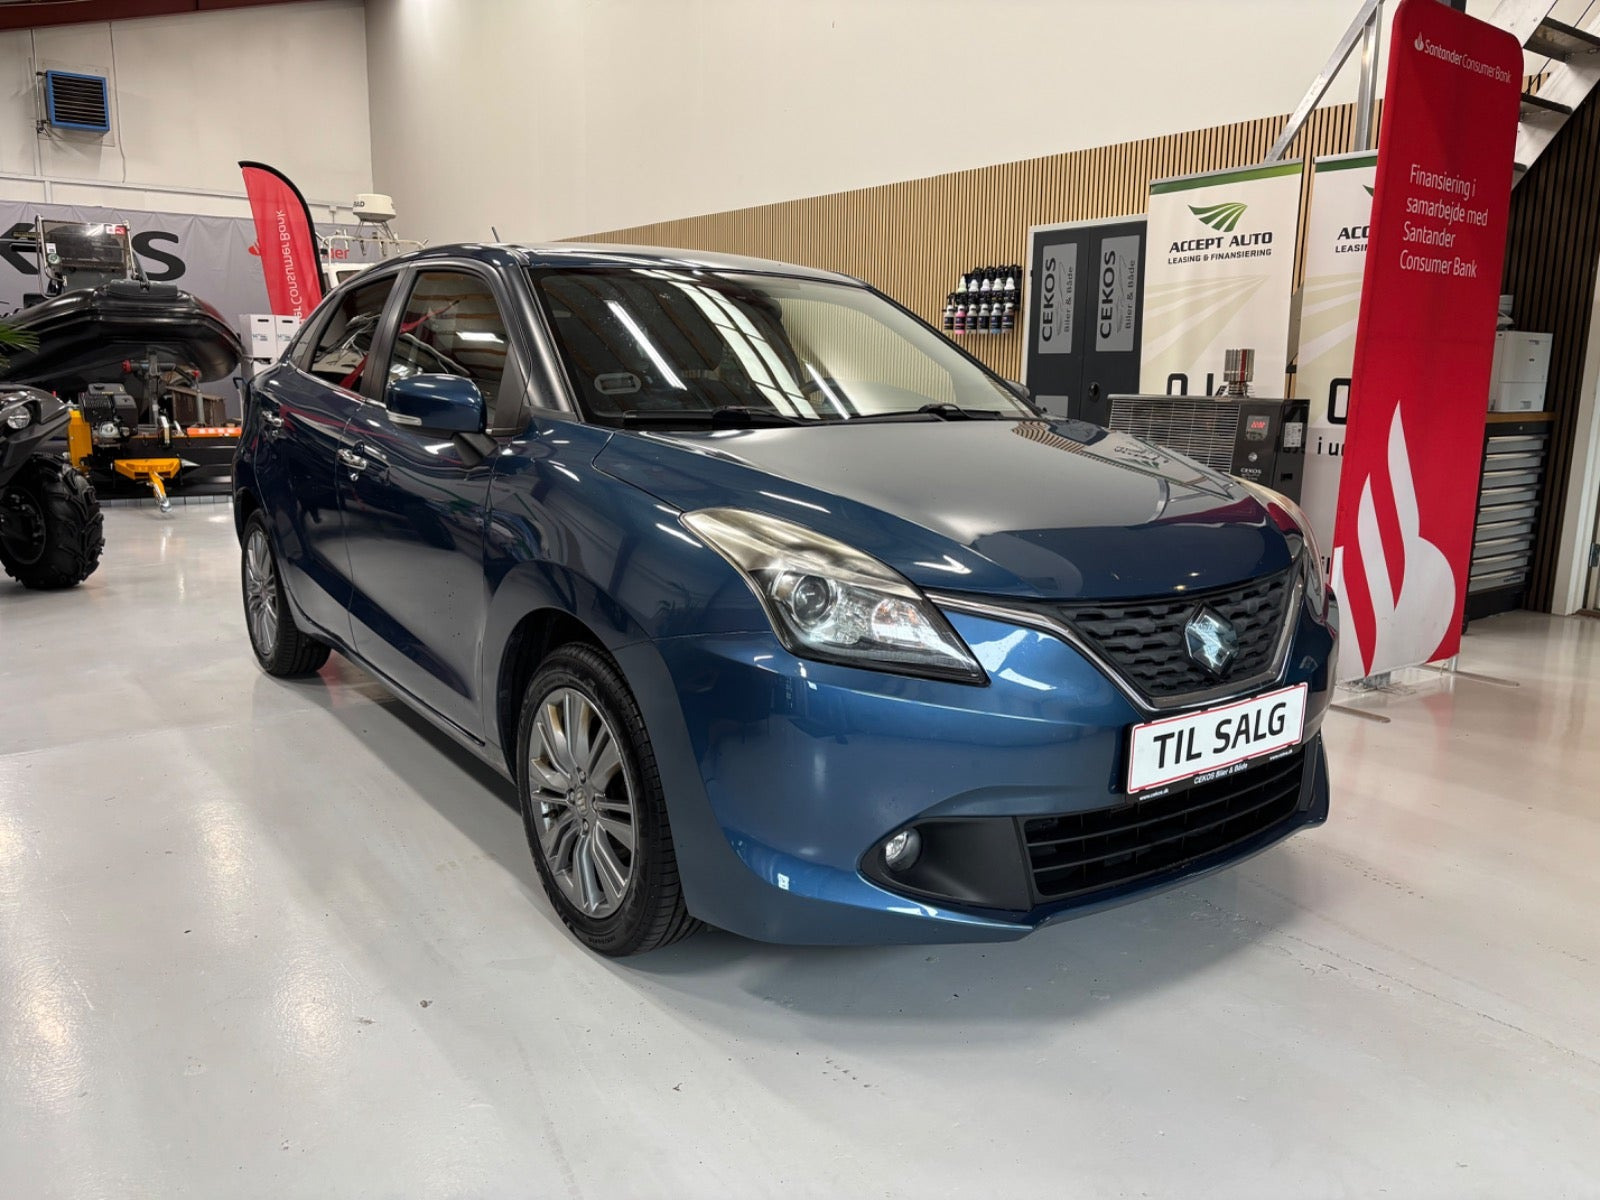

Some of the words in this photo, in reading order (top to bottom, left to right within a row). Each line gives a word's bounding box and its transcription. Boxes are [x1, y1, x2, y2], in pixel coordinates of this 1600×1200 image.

[1424, 39, 1463, 63] Santander
[1462, 53, 1496, 78] Consumer
[1495, 66, 1512, 84] Bank
[1410, 163, 1471, 201] Finansiering
[1472, 178, 1477, 197] i
[1406, 196, 1465, 226] samarbejde
[1467, 208, 1488, 227] med
[1169, 236, 1226, 253] ACCEPT
[1229, 231, 1273, 248] AUTO
[1402, 221, 1456, 249] Santander
[1168, 254, 1201, 265] LEASING
[1210, 248, 1272, 262] FINANSIERING
[1399, 250, 1453, 276] Consumer
[1452, 259, 1478, 279] Bank
[1042, 257, 1057, 342] CEKOS
[1100, 250, 1116, 339] CEKOS
[1153, 727, 1202, 769] TIL
[1213, 702, 1287, 754] SALG
